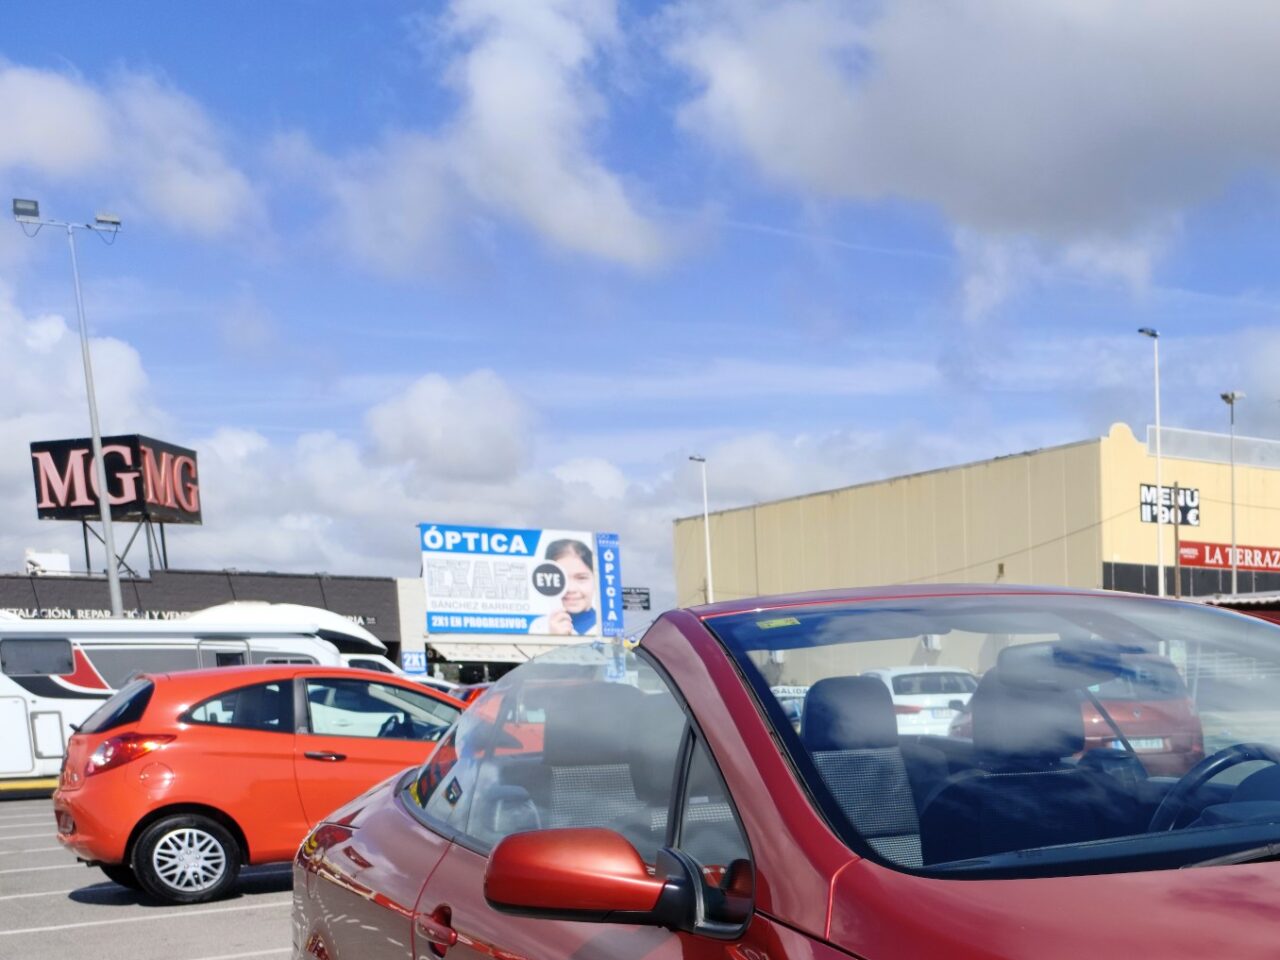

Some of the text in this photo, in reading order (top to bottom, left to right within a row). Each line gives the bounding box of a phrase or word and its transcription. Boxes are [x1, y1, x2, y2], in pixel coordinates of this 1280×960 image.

[32, 444, 140, 508] MG
[140, 445, 199, 512] MG
[423, 525, 529, 554] ÓPTICA
[1204, 545, 1224, 565] LA
[535, 572, 561, 588] EYE
